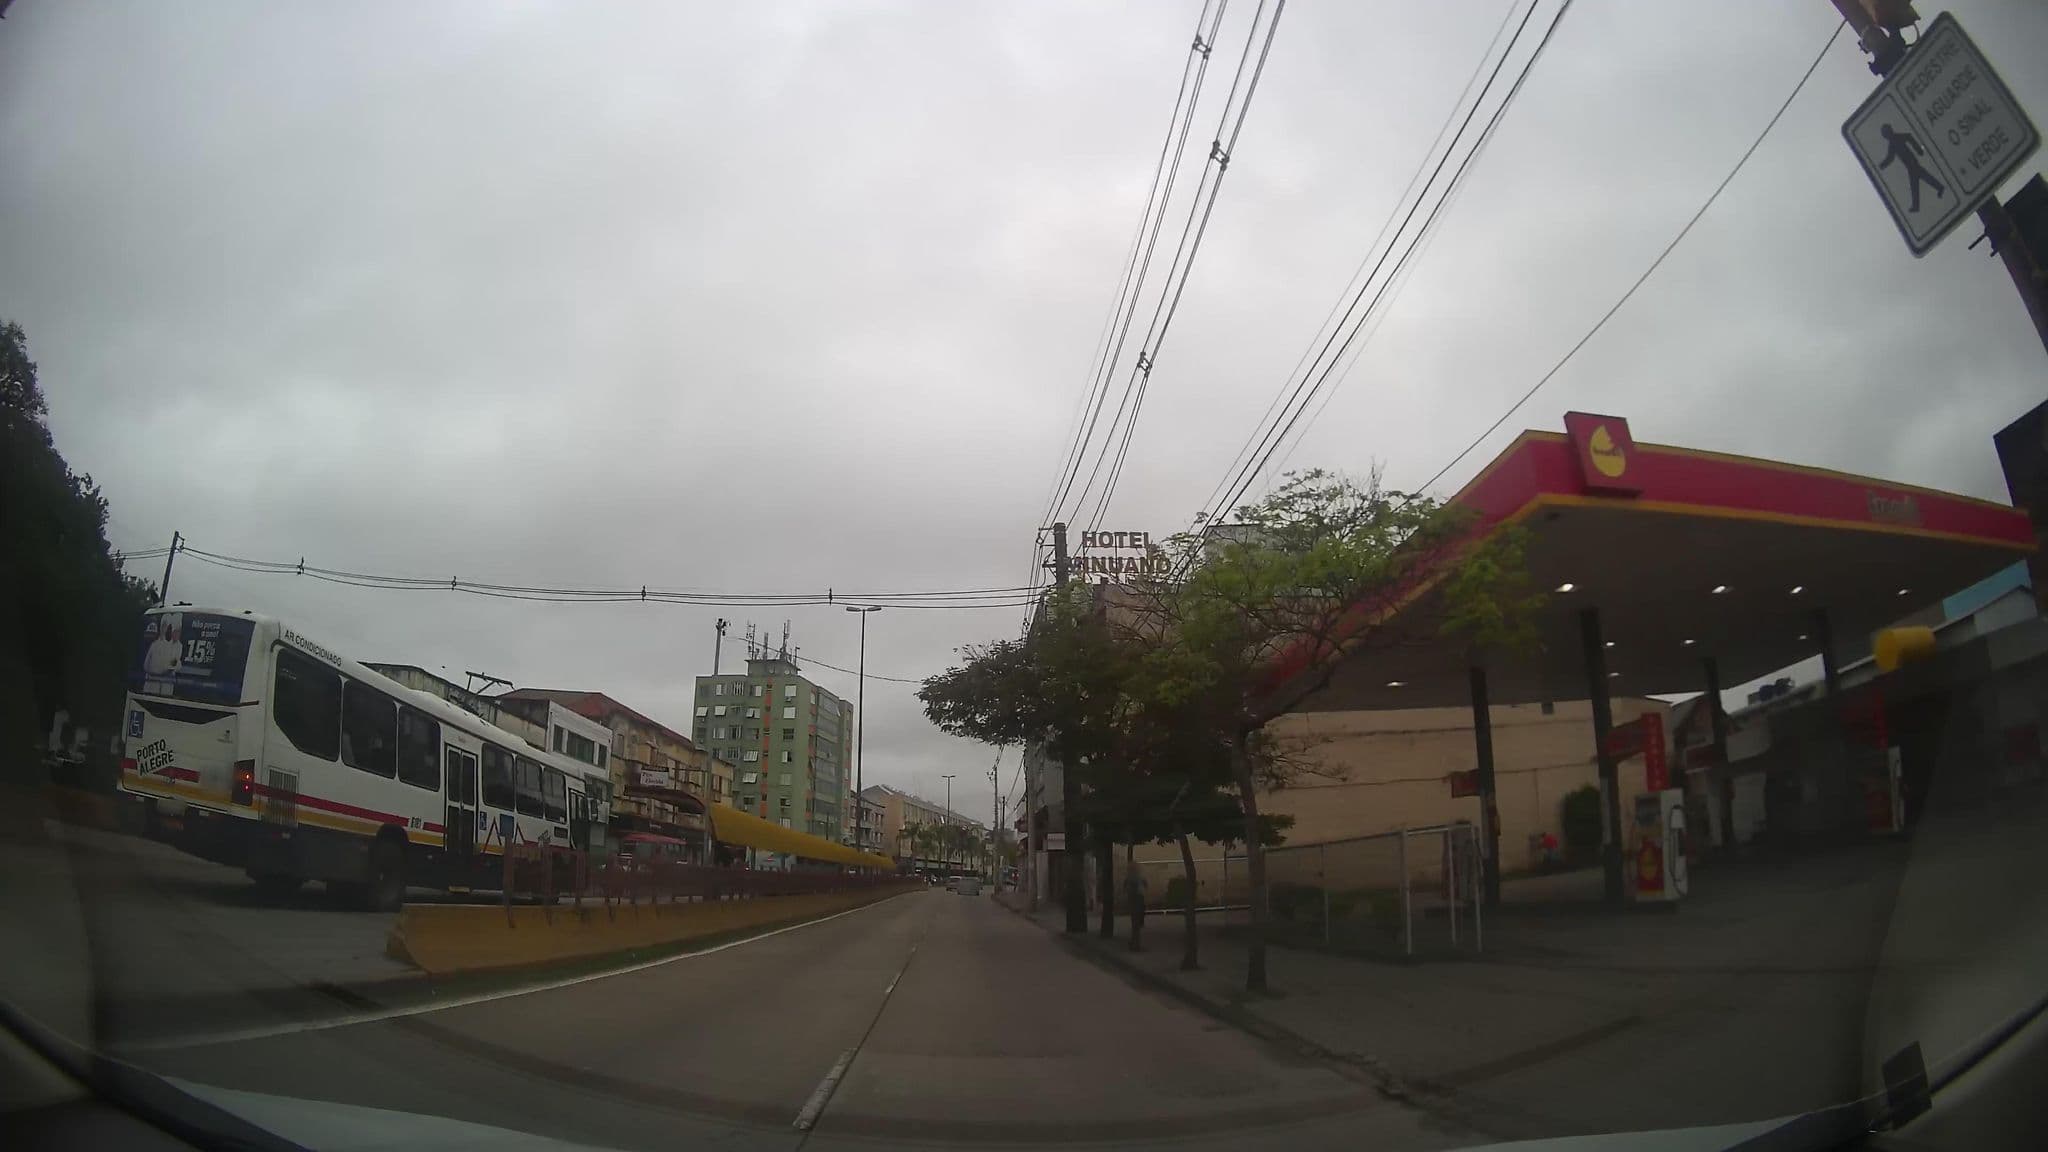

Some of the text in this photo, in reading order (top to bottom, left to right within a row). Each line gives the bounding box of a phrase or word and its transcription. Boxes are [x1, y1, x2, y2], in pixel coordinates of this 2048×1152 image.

[1926, 64, 1977, 128] AGUARDE
[1948, 128, 1961, 147] O
[1967, 126, 2010, 170] VERDE
[1082, 531, 1150, 549] HOTEL
[184, 639, 216, 663] 15%
[284, 629, 342, 667] AR CONDICIONADO
[136, 738, 167, 762] PORTO
[139, 749, 175, 777] ALEGRE
